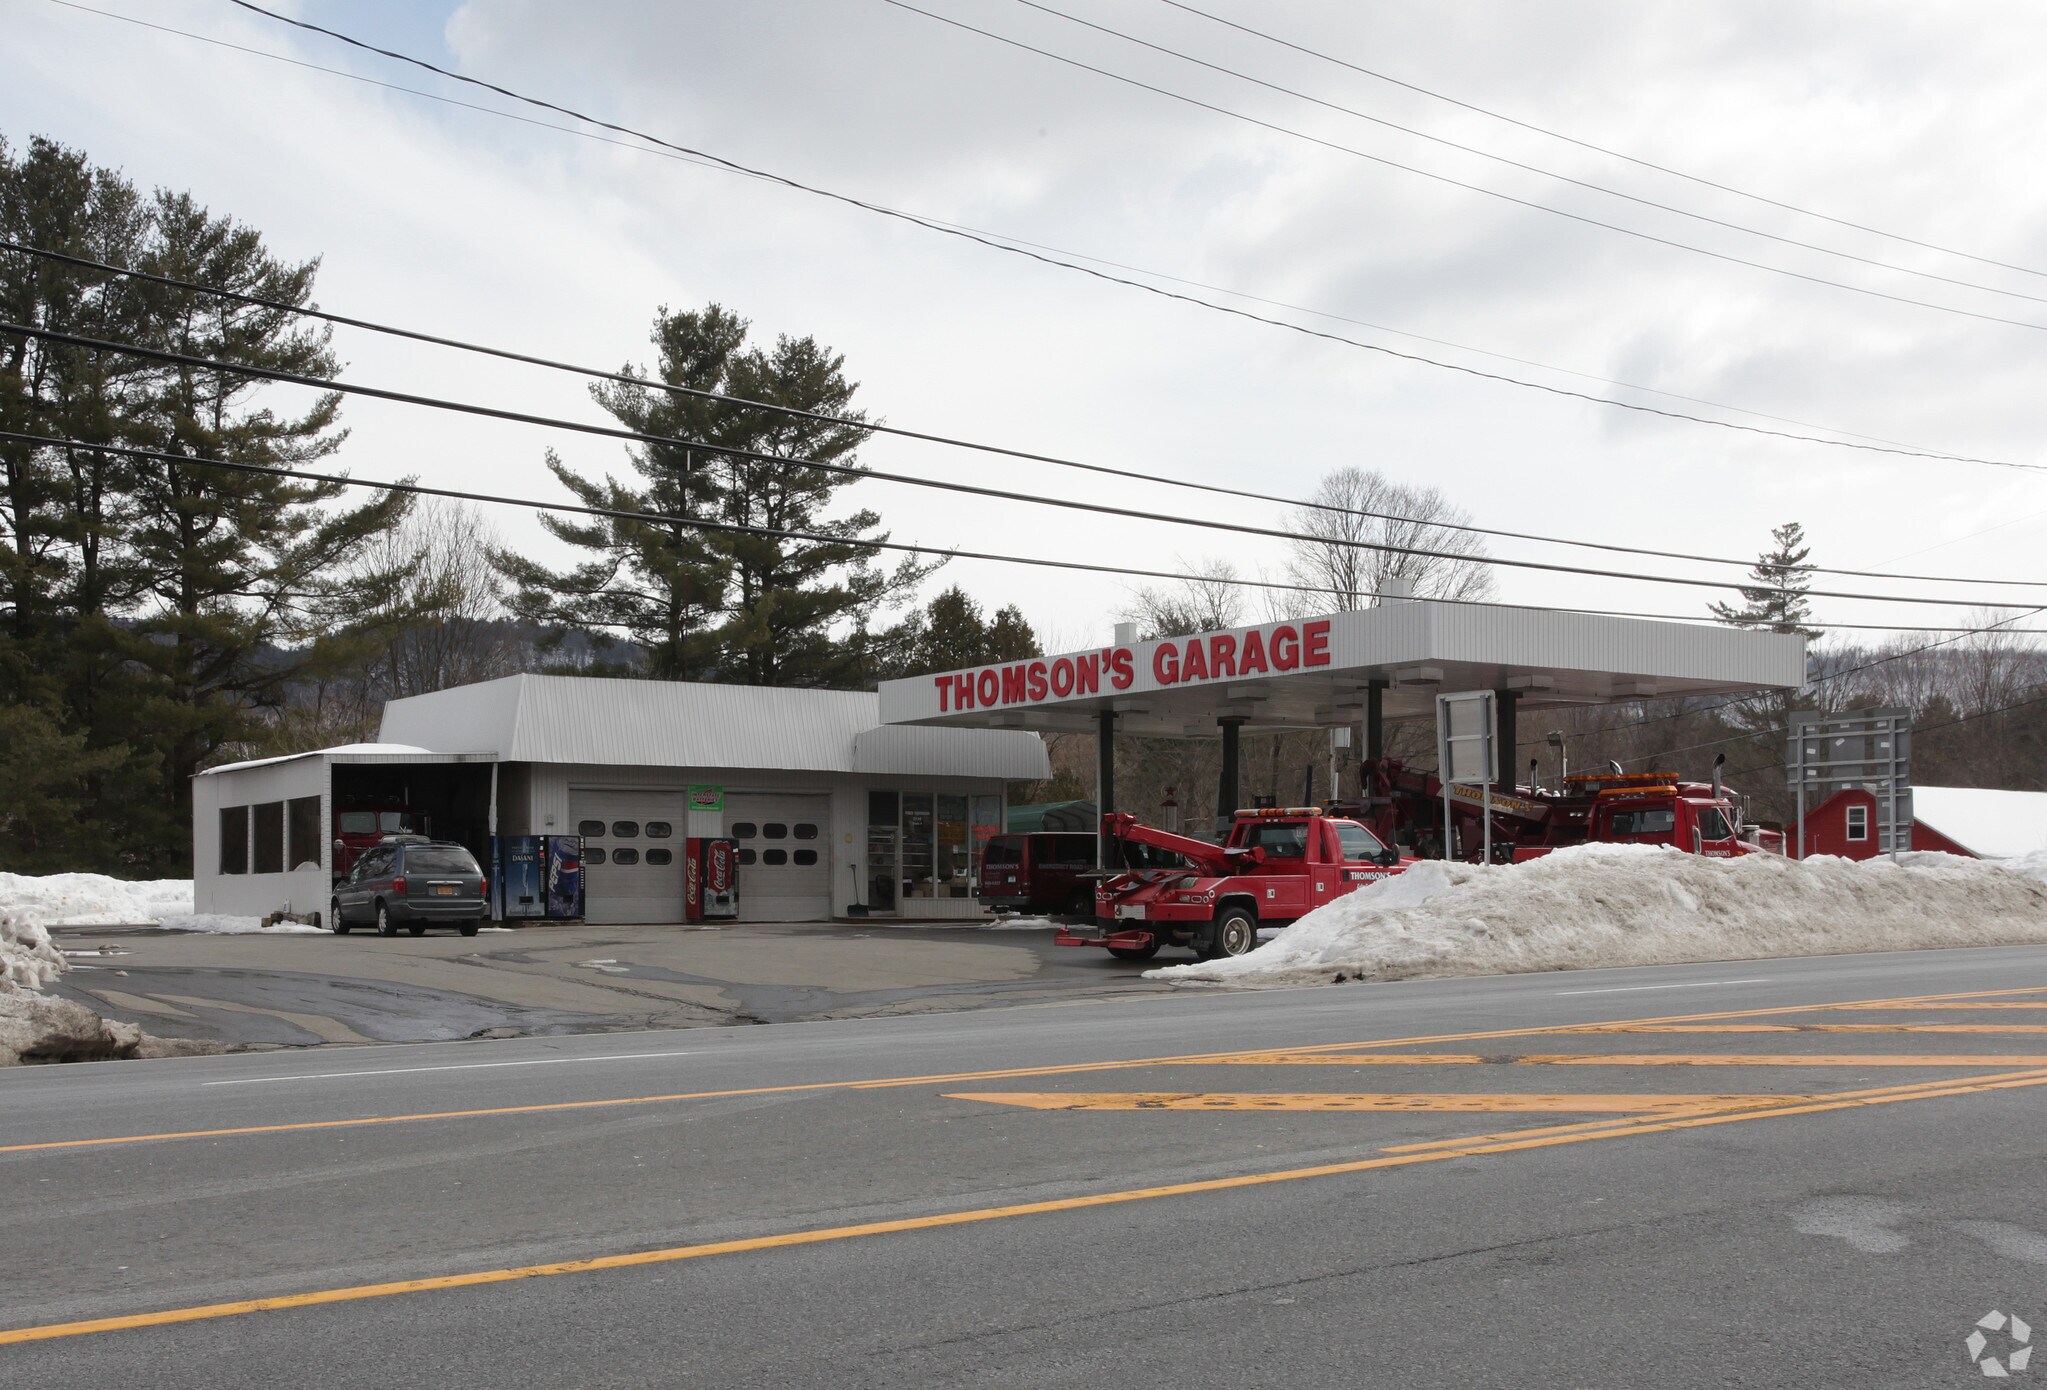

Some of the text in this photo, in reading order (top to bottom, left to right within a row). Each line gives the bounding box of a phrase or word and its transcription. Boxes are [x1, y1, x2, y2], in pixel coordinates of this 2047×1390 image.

[935, 619, 1331, 712] THOMSON'S GARAGE
[512, 854, 534, 862] DASANI
[548, 851, 563, 893] PEPSI
[1350, 872, 1391, 880] THOMSON'S
